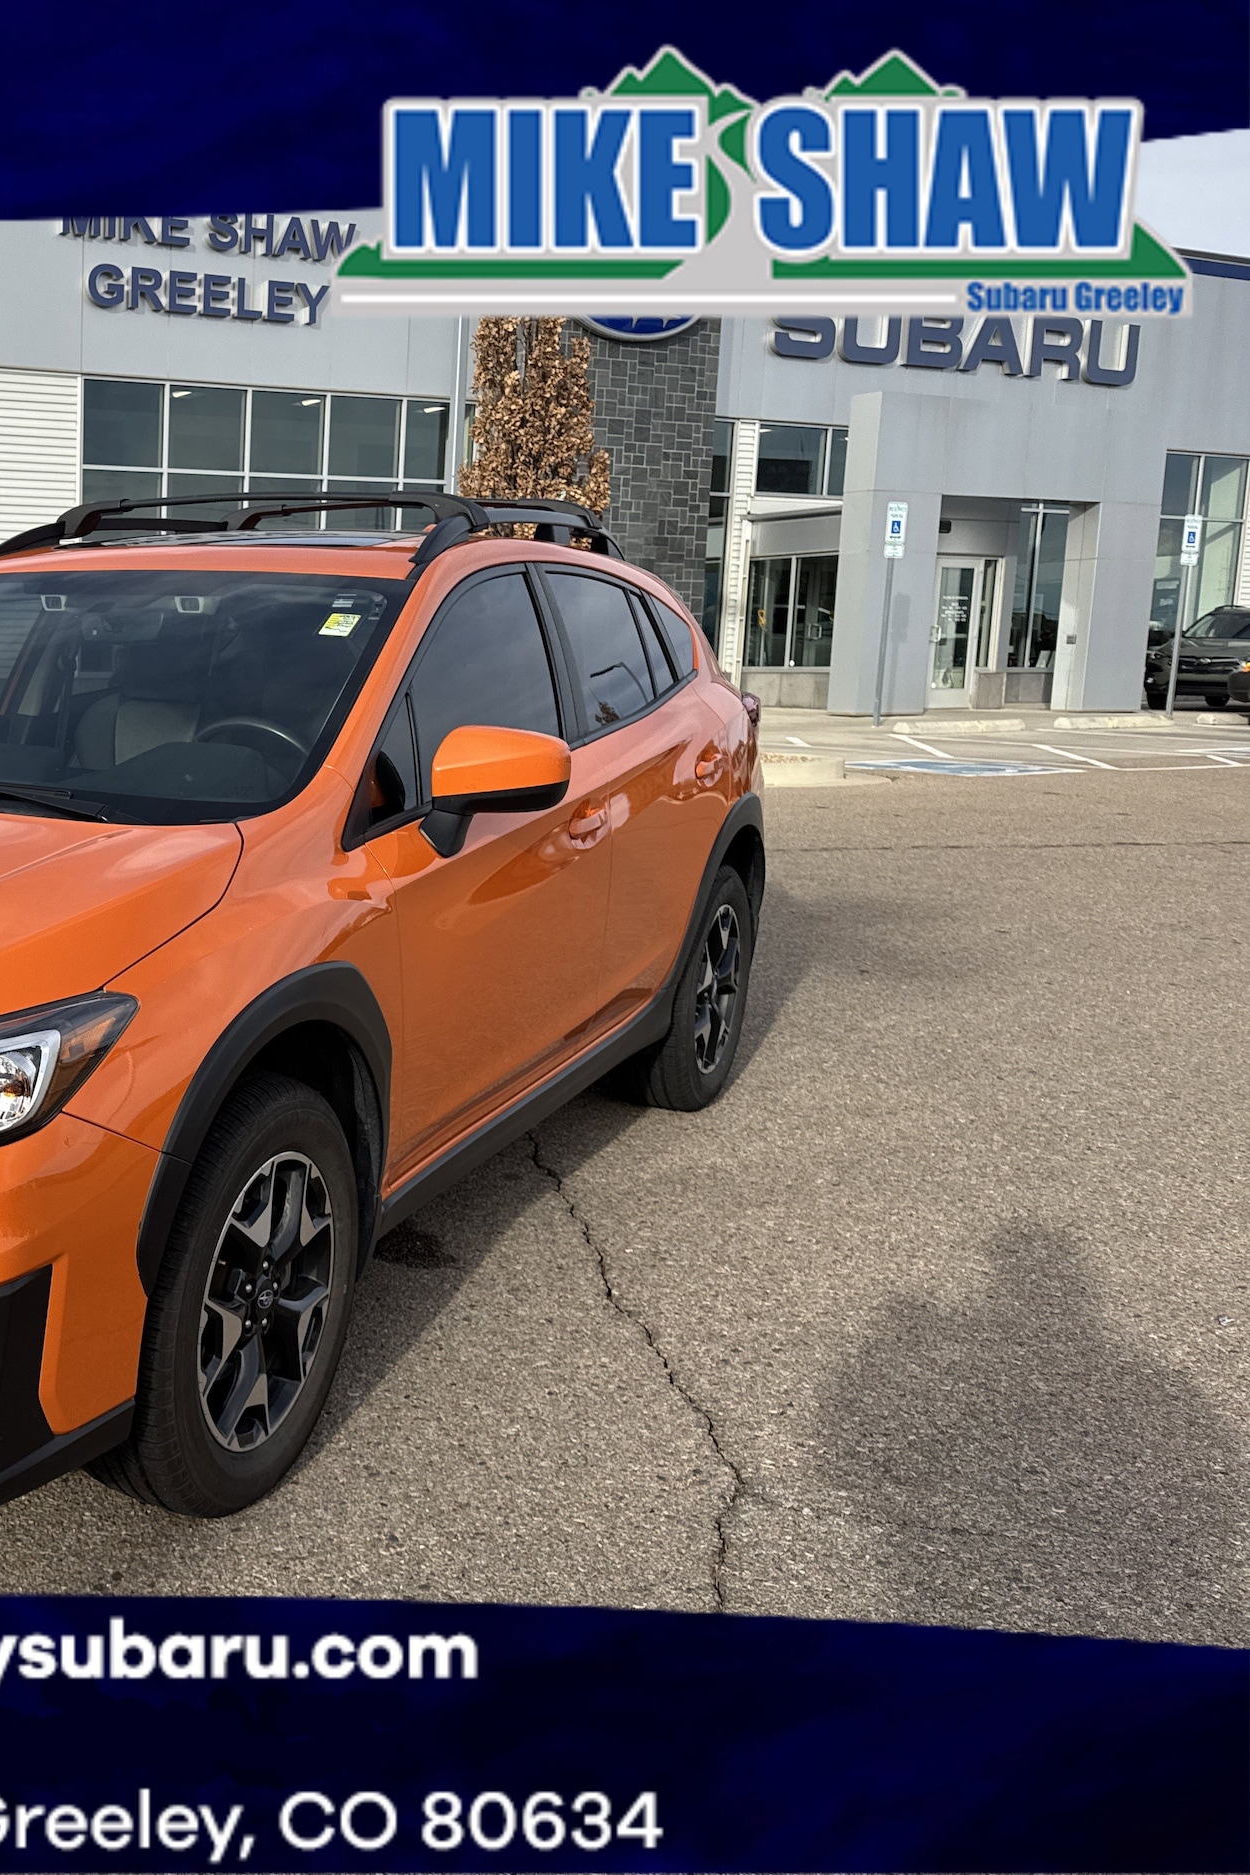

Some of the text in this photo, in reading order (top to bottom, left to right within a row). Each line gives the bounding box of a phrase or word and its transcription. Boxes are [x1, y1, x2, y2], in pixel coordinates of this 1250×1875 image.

[208, 213, 357, 261] SHAW
[87, 263, 330, 325] GREELEY
[771, 313, 1141, 386] SUBARU
